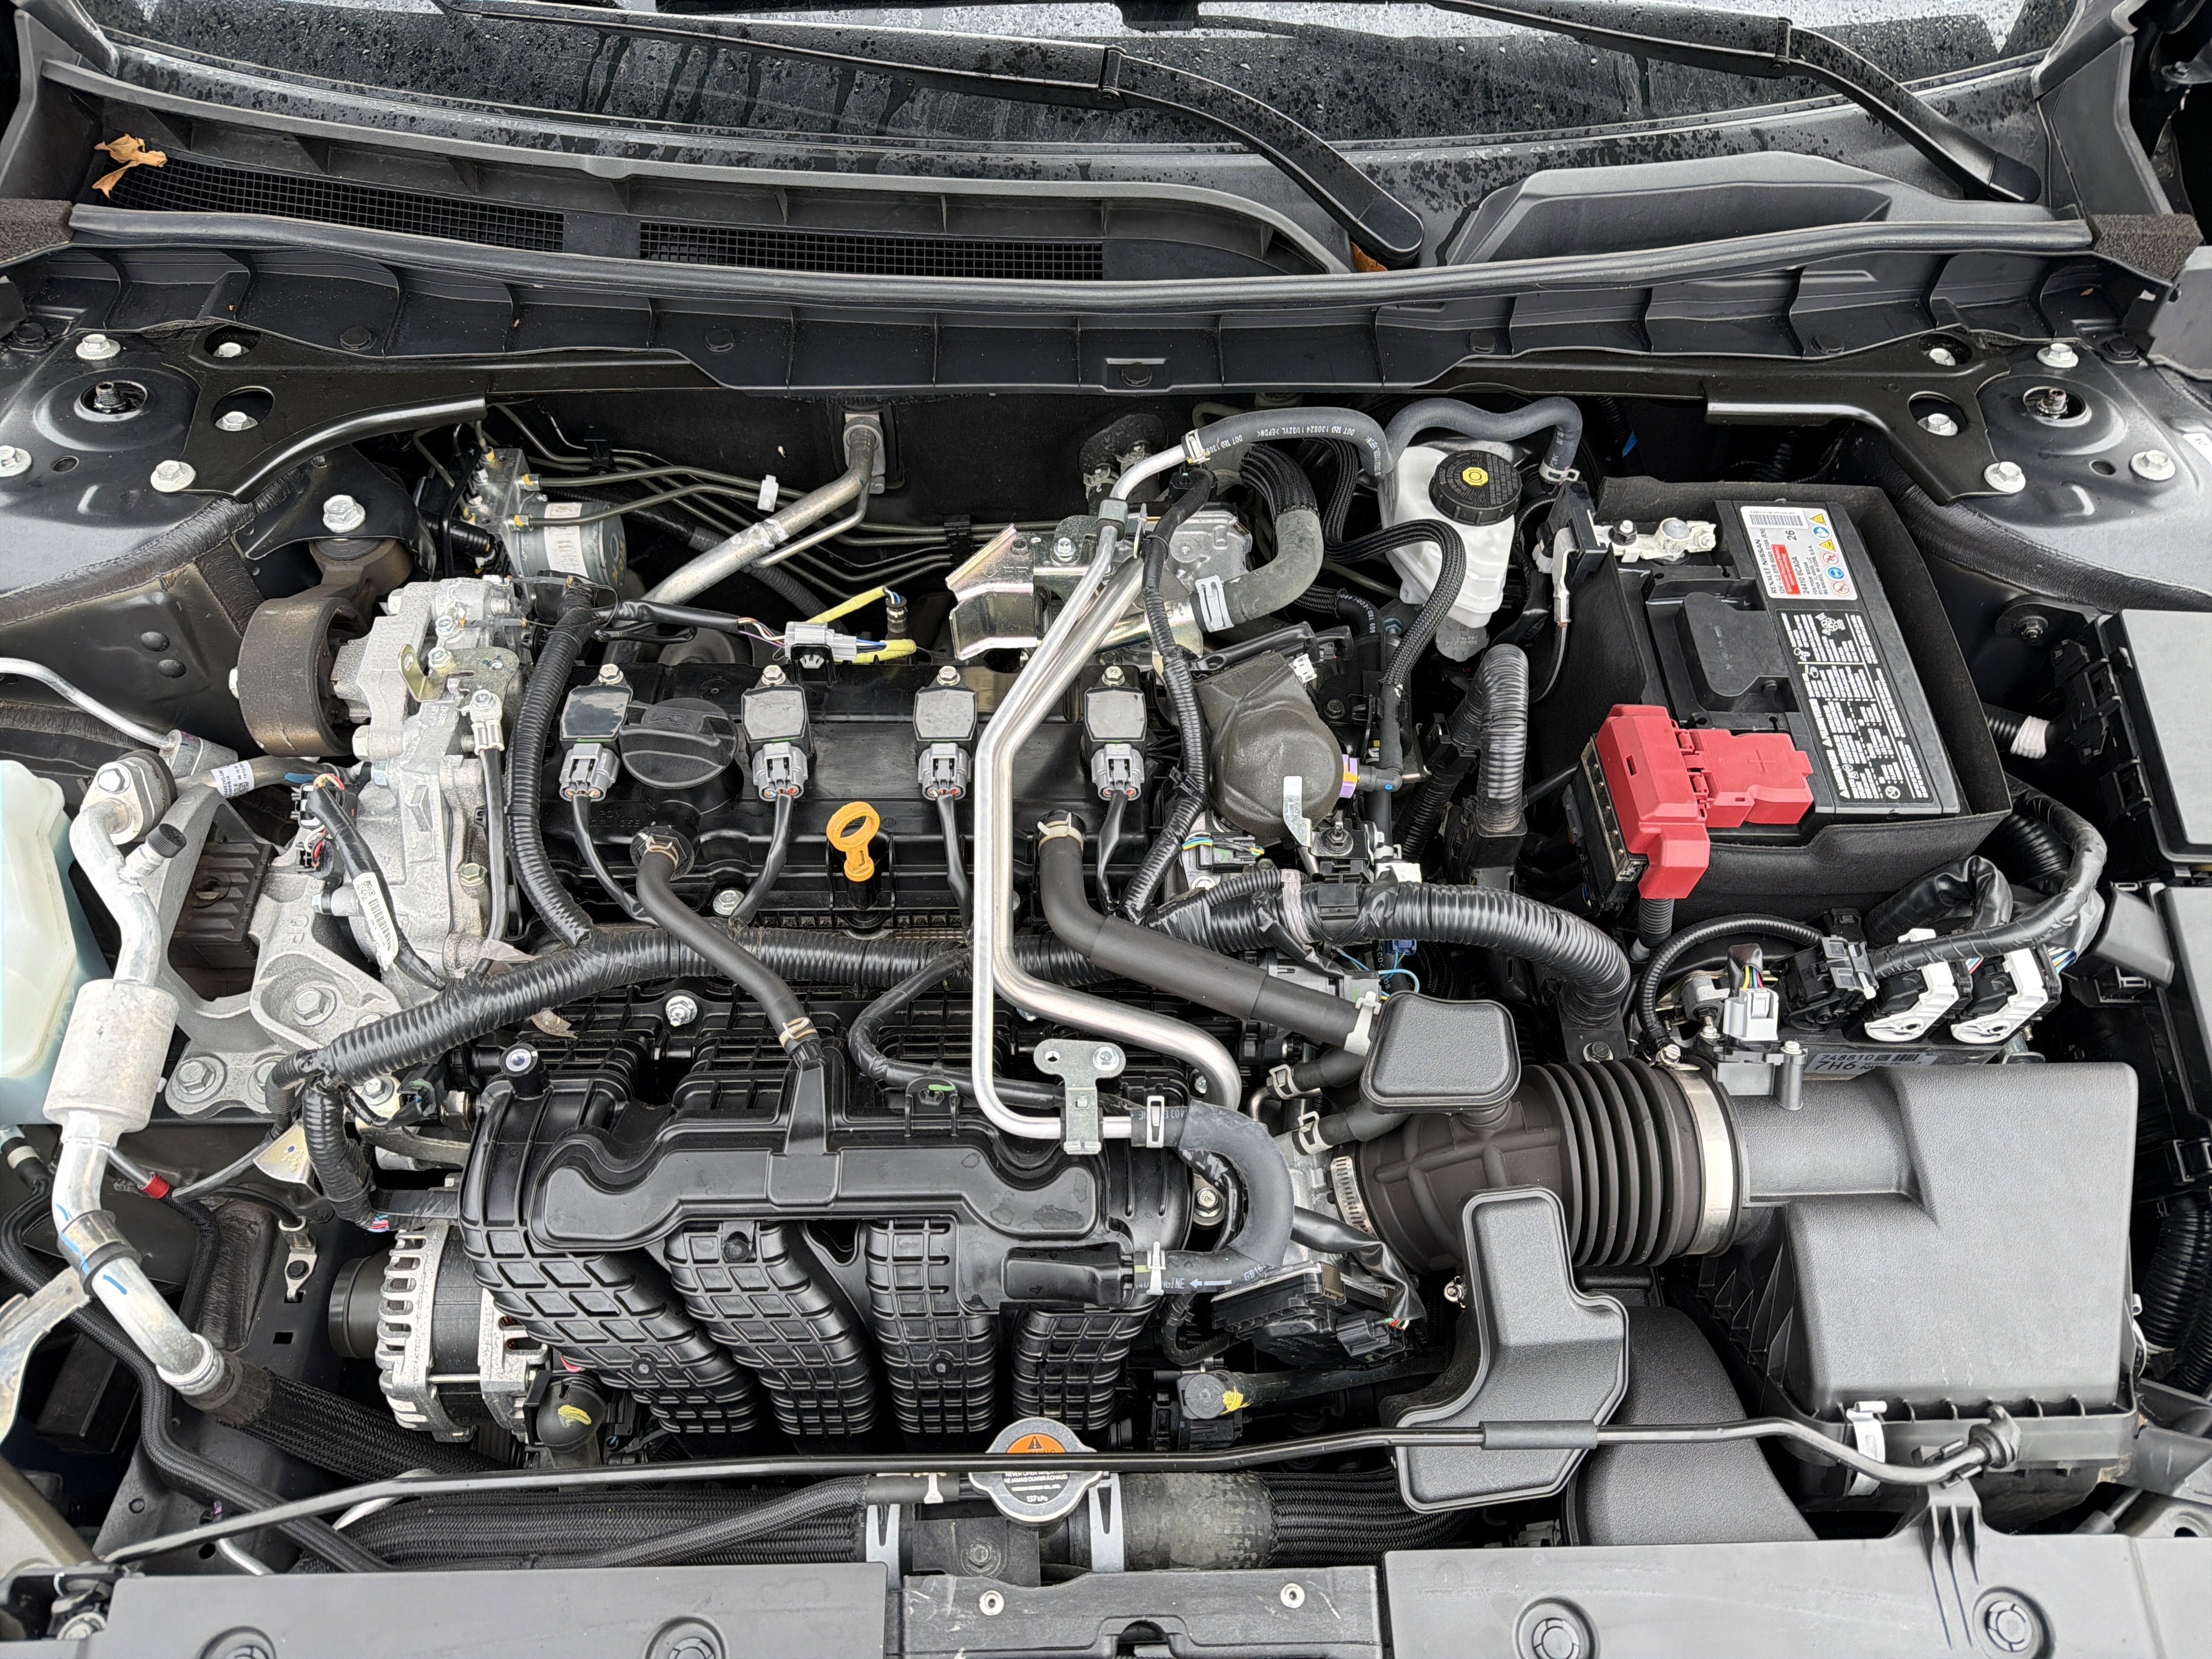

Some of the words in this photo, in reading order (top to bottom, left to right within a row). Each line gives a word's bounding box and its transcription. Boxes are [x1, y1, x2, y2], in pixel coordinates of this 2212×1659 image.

[1306, 425, 1329, 433] 130624
[1342, 428, 1356, 437] DOT
[1232, 434, 1243, 445] DOT
[1785, 529, 1797, 540] 26
[1755, 538, 1768, 565] NISSAN
[1764, 567, 1778, 594] RENAULT
[1814, 1060, 1857, 1070] 7H6
